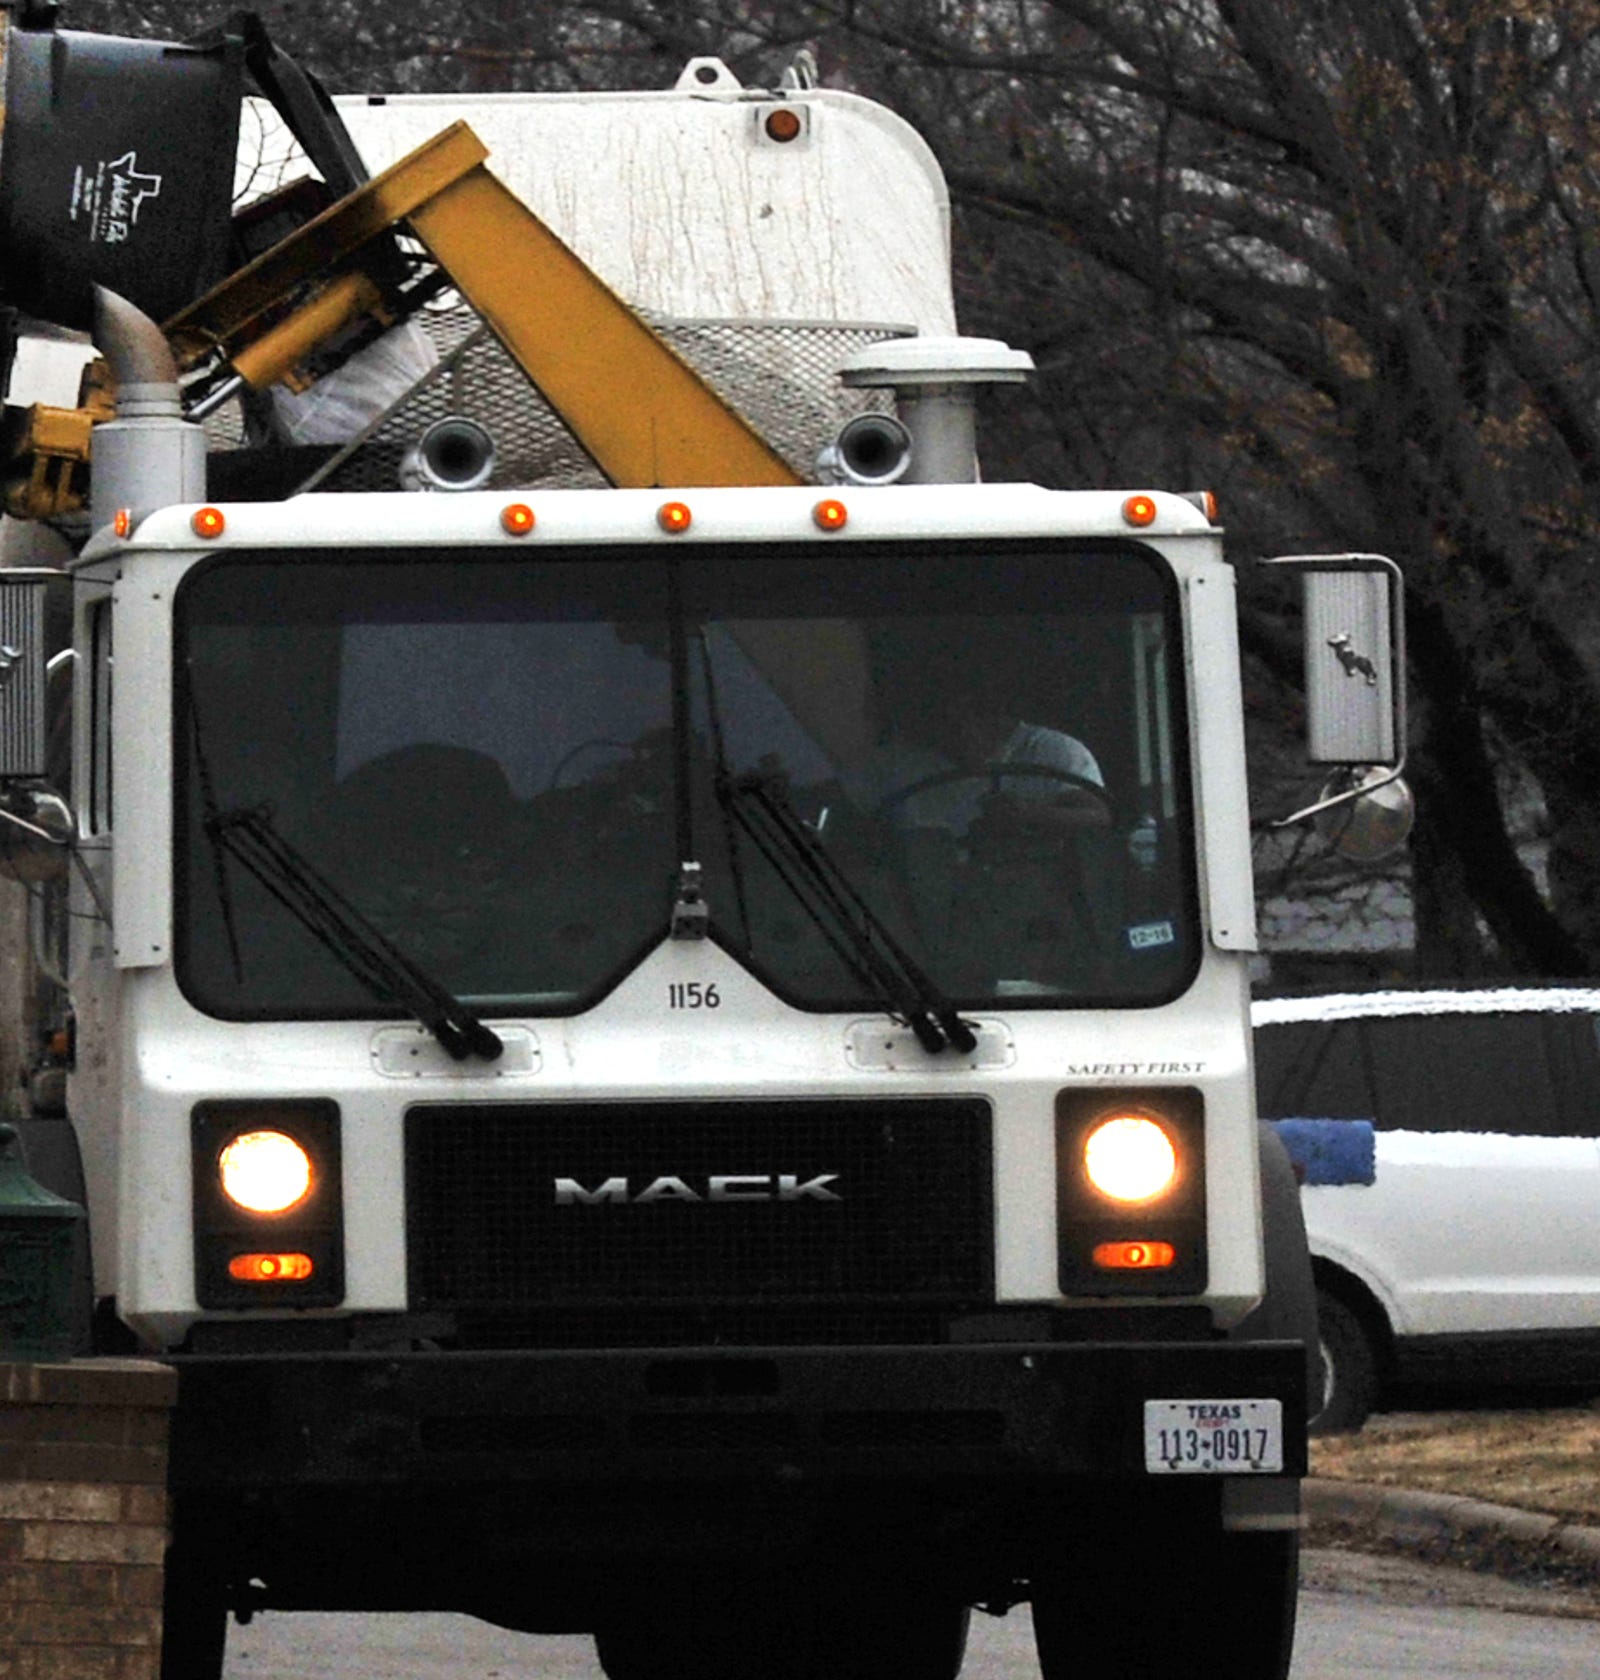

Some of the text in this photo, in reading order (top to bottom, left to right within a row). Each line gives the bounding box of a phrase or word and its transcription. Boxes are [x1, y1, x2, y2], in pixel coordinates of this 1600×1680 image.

[668, 982, 721, 1009] 1156
[1066, 1061, 1206, 1076] SAFETY FIRST
[553, 1173, 844, 1205] MACK
[1187, 1404, 1242, 1419] TEXAS
